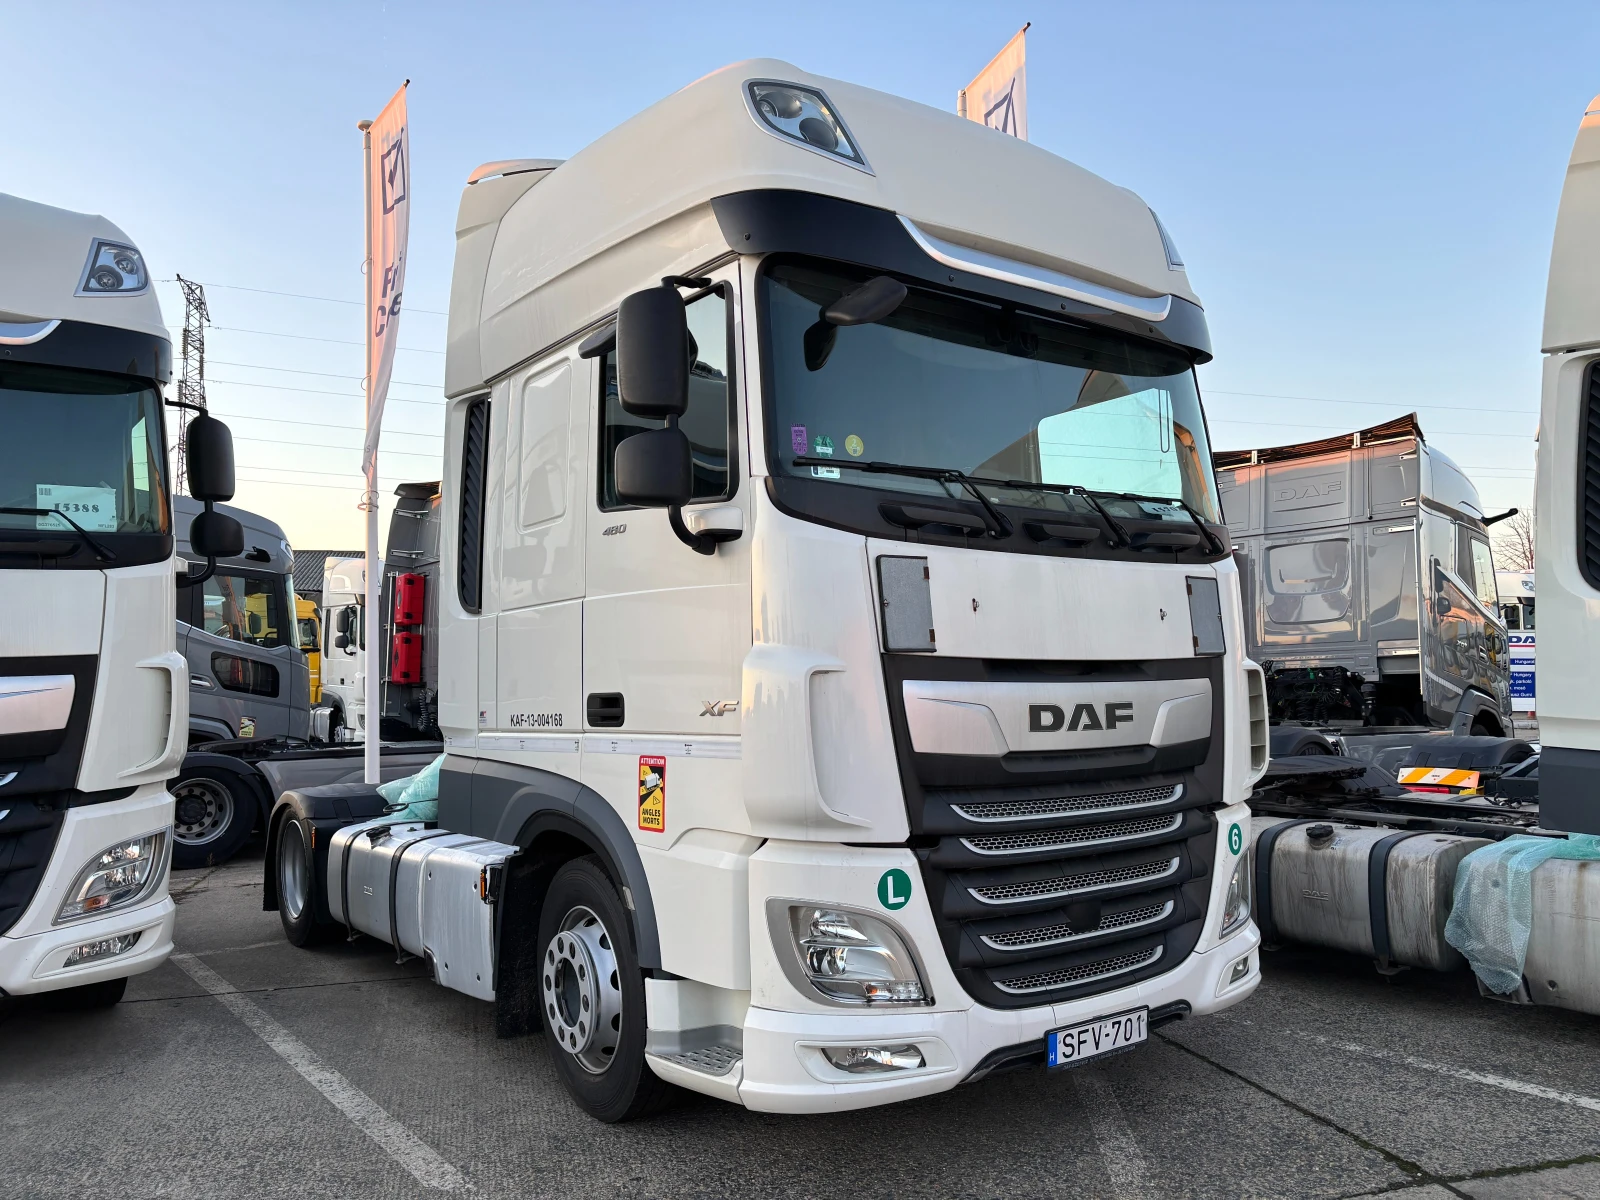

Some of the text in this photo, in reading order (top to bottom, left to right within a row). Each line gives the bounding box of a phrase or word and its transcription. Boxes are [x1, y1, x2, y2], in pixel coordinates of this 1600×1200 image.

[1273, 481, 1341, 502] DAF
[602, 523, 627, 536] 480
[699, 700, 739, 716] XF
[510, 713, 563, 727] KAF-13-004168
[1028, 702, 1134, 732] DAF
[640, 757, 665, 765] ATTENTION
[641, 808, 661, 818] ANGLES
[642, 816, 660, 826] MORTS
[1231, 827, 1239, 851] 6
[887, 875, 905, 904] L
[1049, 1052, 1055, 1061] H
[1062, 1014, 1142, 1059] SFV-701
